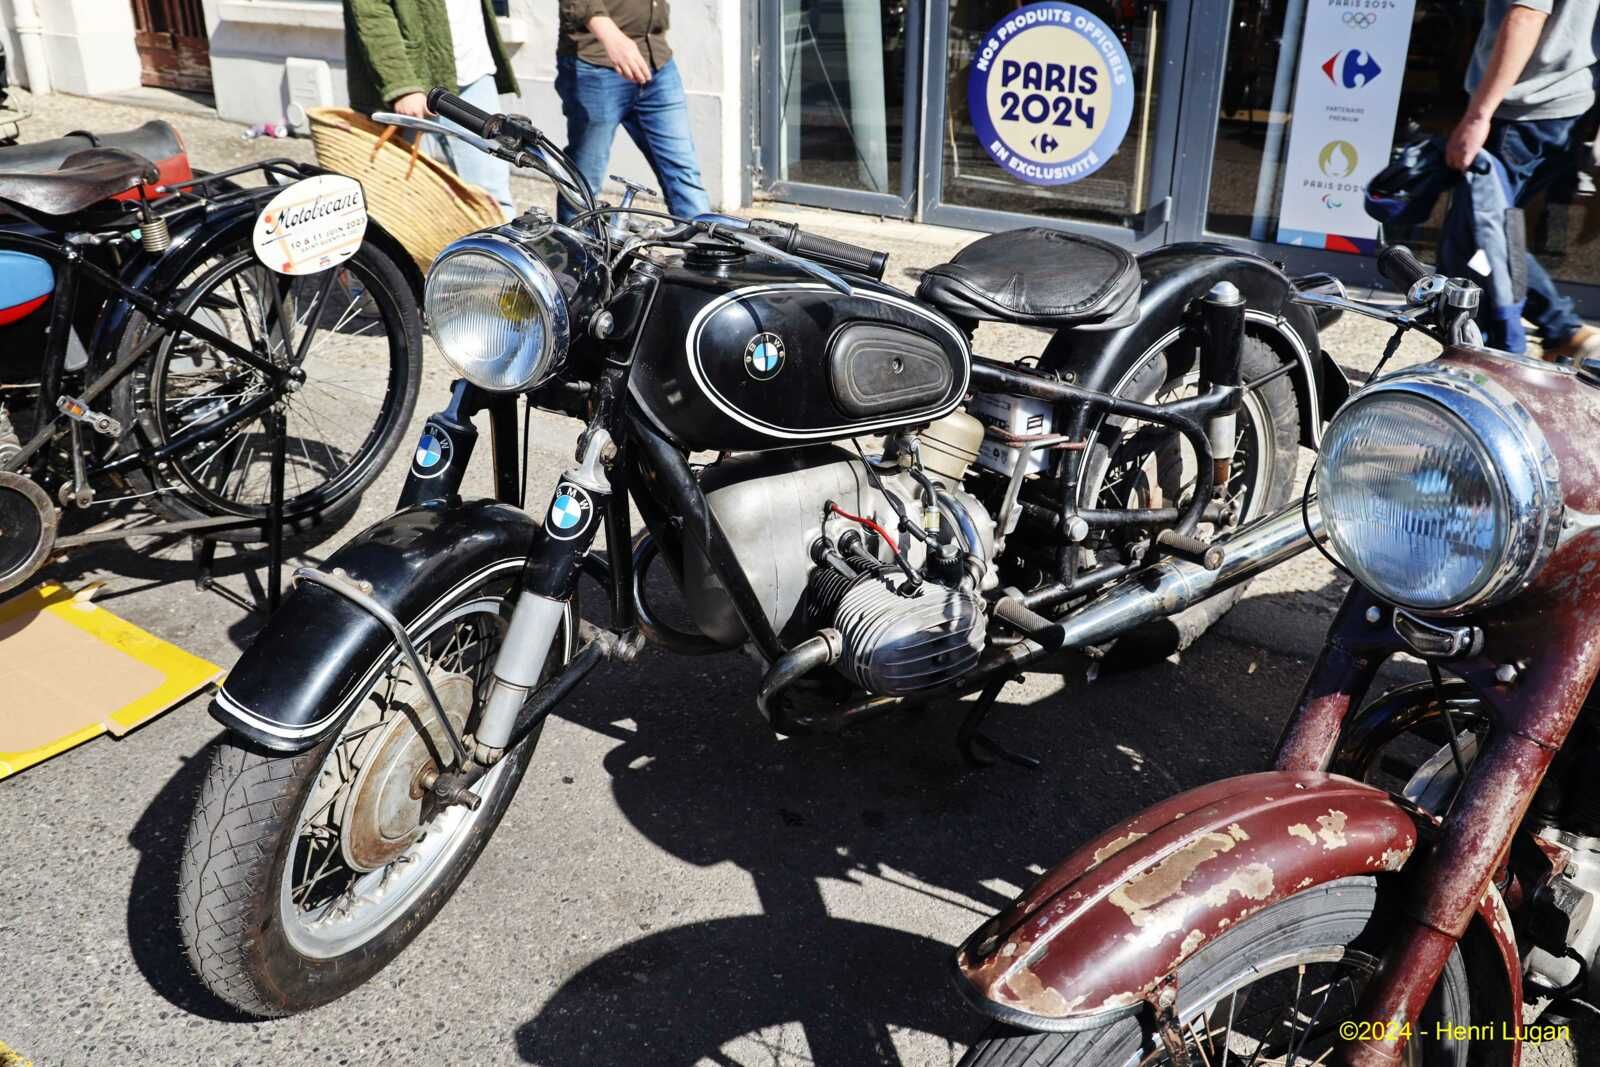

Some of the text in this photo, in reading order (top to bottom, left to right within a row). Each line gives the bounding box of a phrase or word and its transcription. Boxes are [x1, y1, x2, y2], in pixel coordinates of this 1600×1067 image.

[976, 8, 1127, 86] NOS PRODUITS OFFICIELS
[1001, 59, 1098, 95] PARIS
[1000, 91, 1095, 129] 2024
[1326, 105, 1365, 114] PARTENAIRE
[1329, 114, 1359, 122] PREMIUM
[990, 140, 1100, 180] EN EXCLUSIVITÉ
[1303, 179, 1333, 190] PARIS
[748, 334, 782, 352] BMW
[556, 487, 589, 510] BMW
